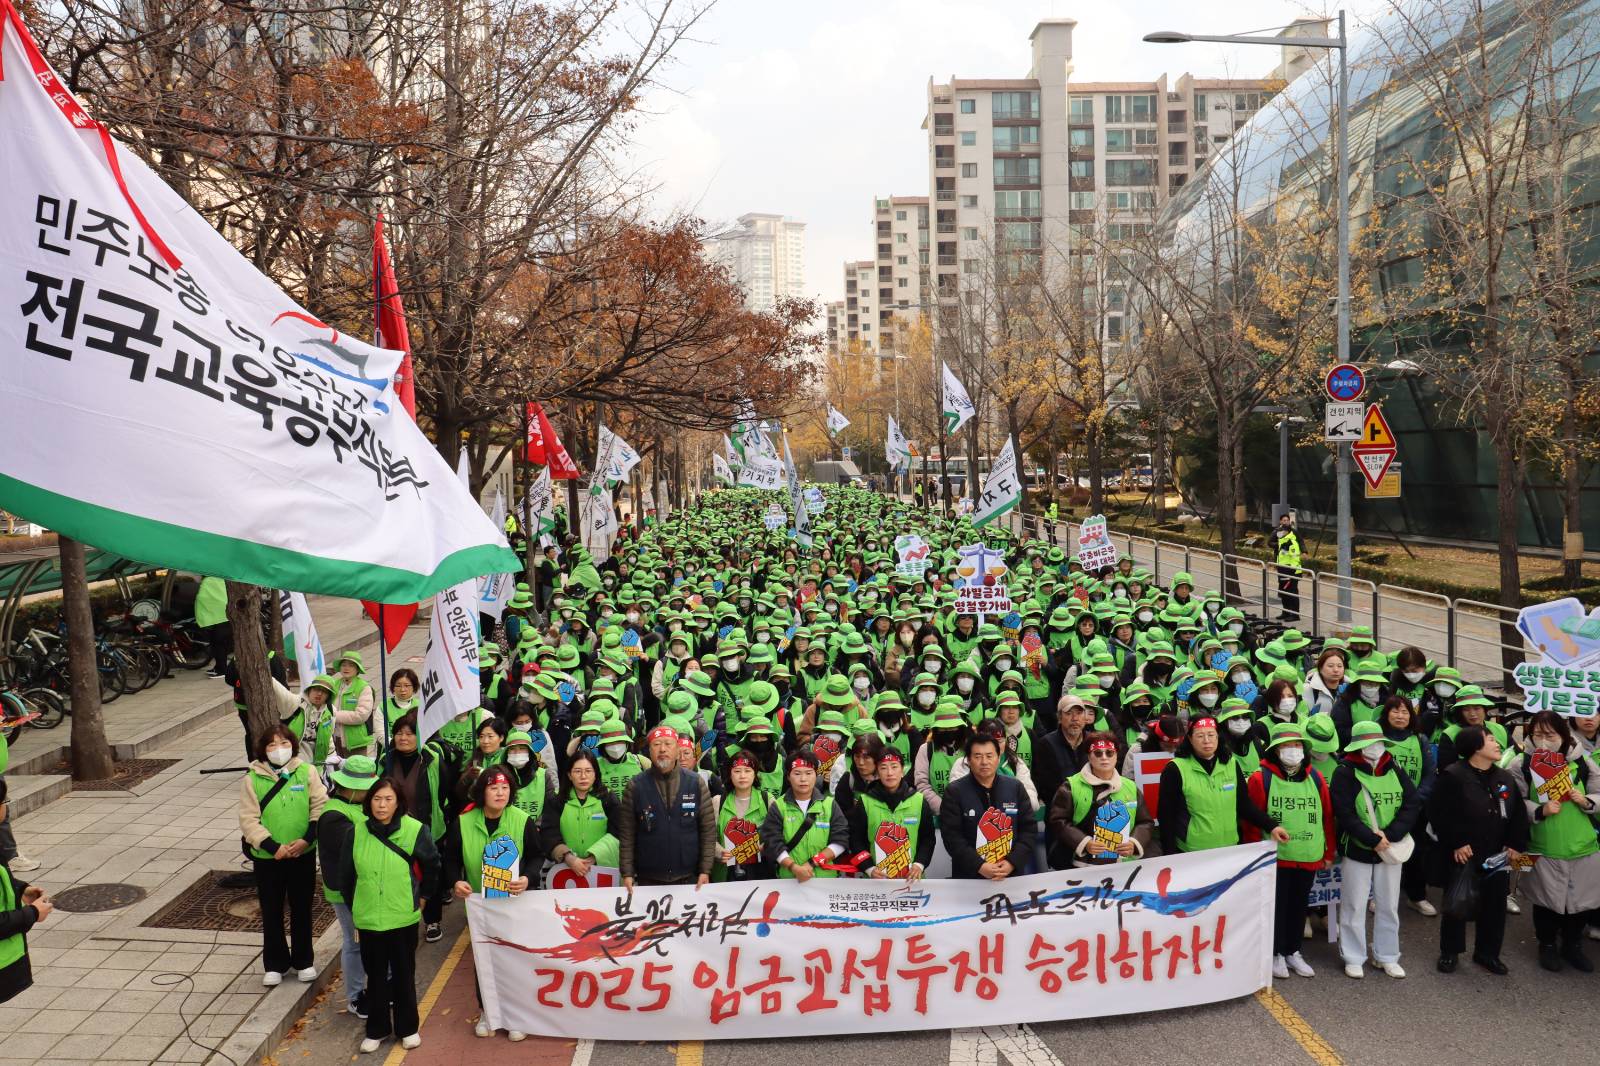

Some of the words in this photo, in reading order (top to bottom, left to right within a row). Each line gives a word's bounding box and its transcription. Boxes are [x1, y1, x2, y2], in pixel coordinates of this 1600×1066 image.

[960, 587, 1005, 599] 차별금지
[955, 601, 1011, 613] 명절휴가비
[1272, 796, 1316, 810] 비정규직
[829, 900, 919, 912] 전국교육공무직본부
[534, 962, 673, 1013] 2025
[1025, 916, 1227, 995] 승리하자!
